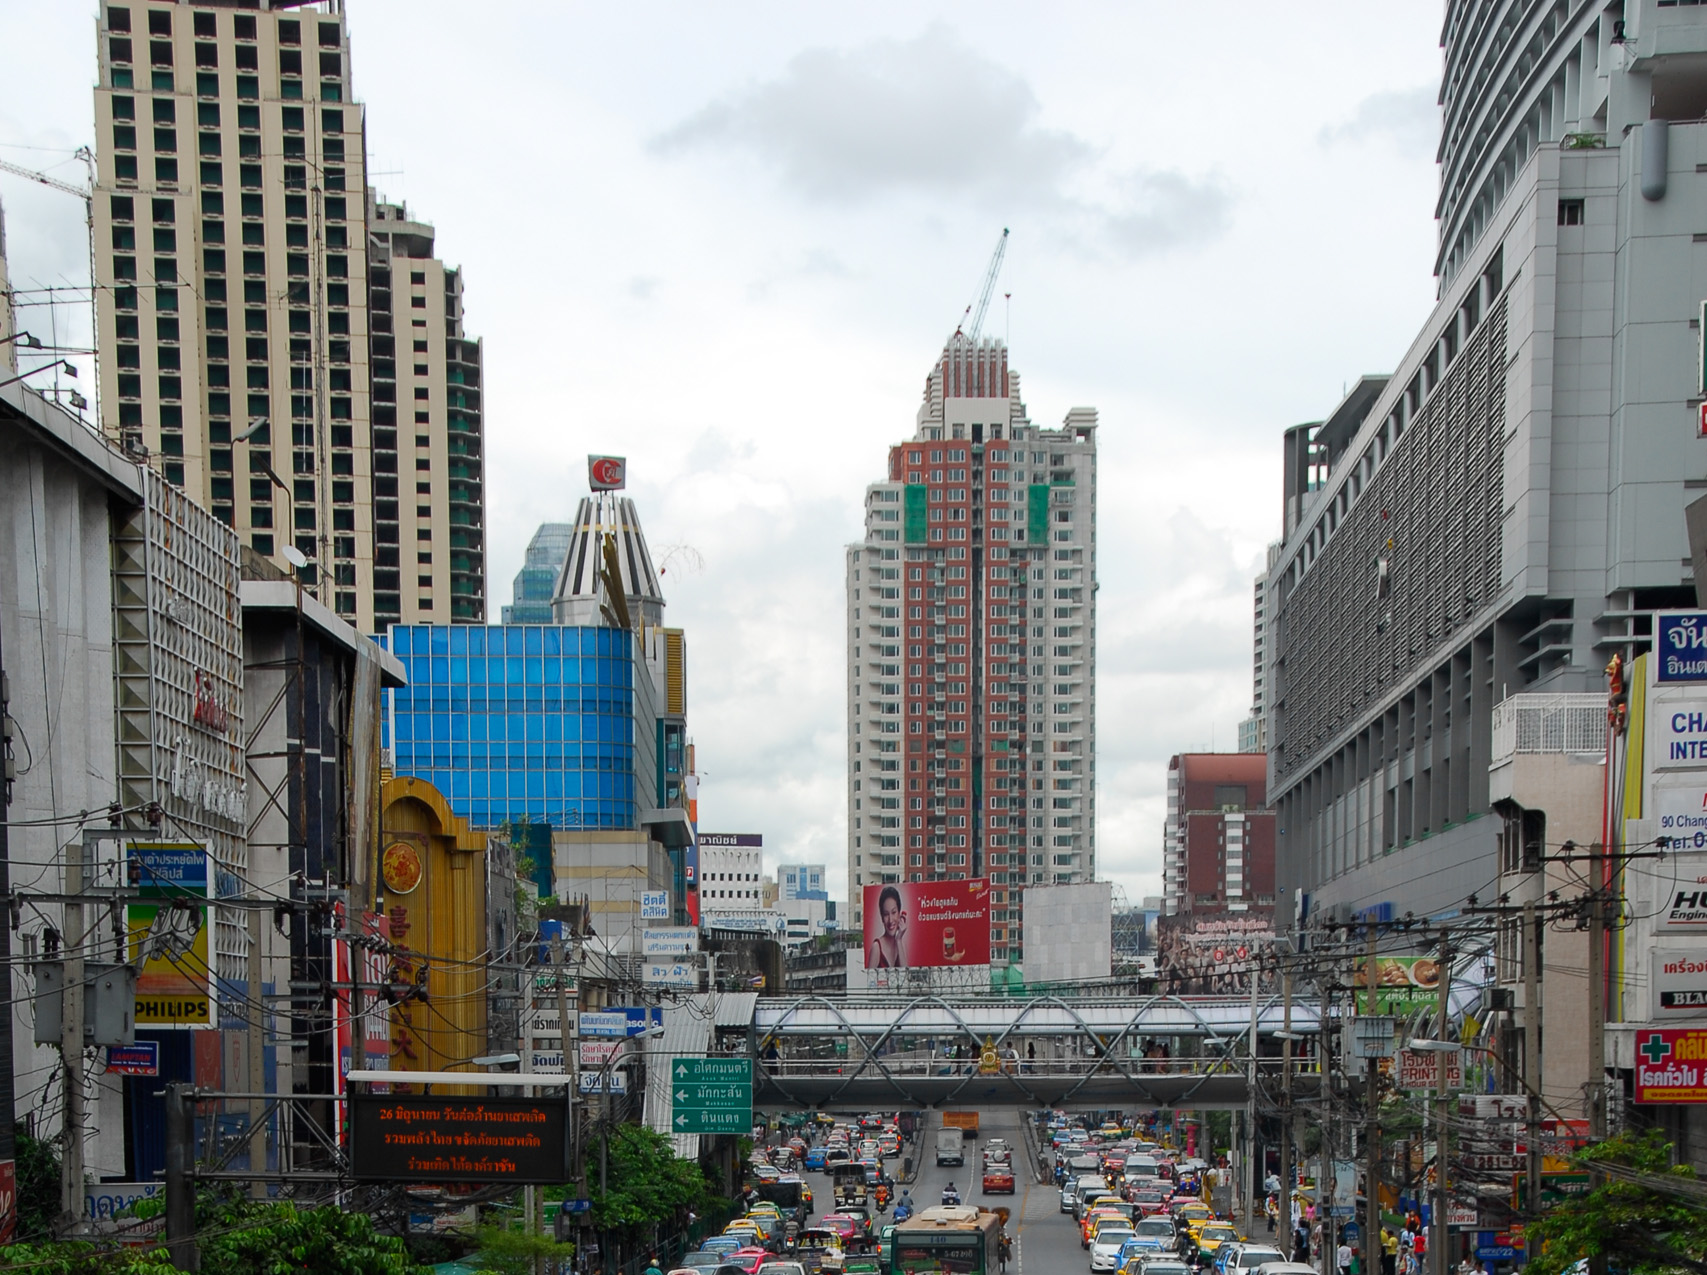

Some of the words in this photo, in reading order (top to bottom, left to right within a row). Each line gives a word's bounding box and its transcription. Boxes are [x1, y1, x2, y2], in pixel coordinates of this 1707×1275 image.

[1667, 656, 1707, 675] อินเต
[1670, 741, 1707, 760] INTE
[1661, 815, 1674, 828] 90
[1669, 909, 1707, 922] Engin
[1663, 958, 1707, 975] เครื่อง
[134, 1001, 208, 1018] PHILIPS
[694, 1060, 748, 1074] อโศกมนตรี
[1639, 1062, 1698, 1087] โรคทั่วไป
[697, 1085, 743, 1098] มักกะสัน
[379, 1109, 393, 1120] 26
[395, 1106, 441, 1124] มิถุนายน
[701, 1111, 739, 1124] ดินแดง
